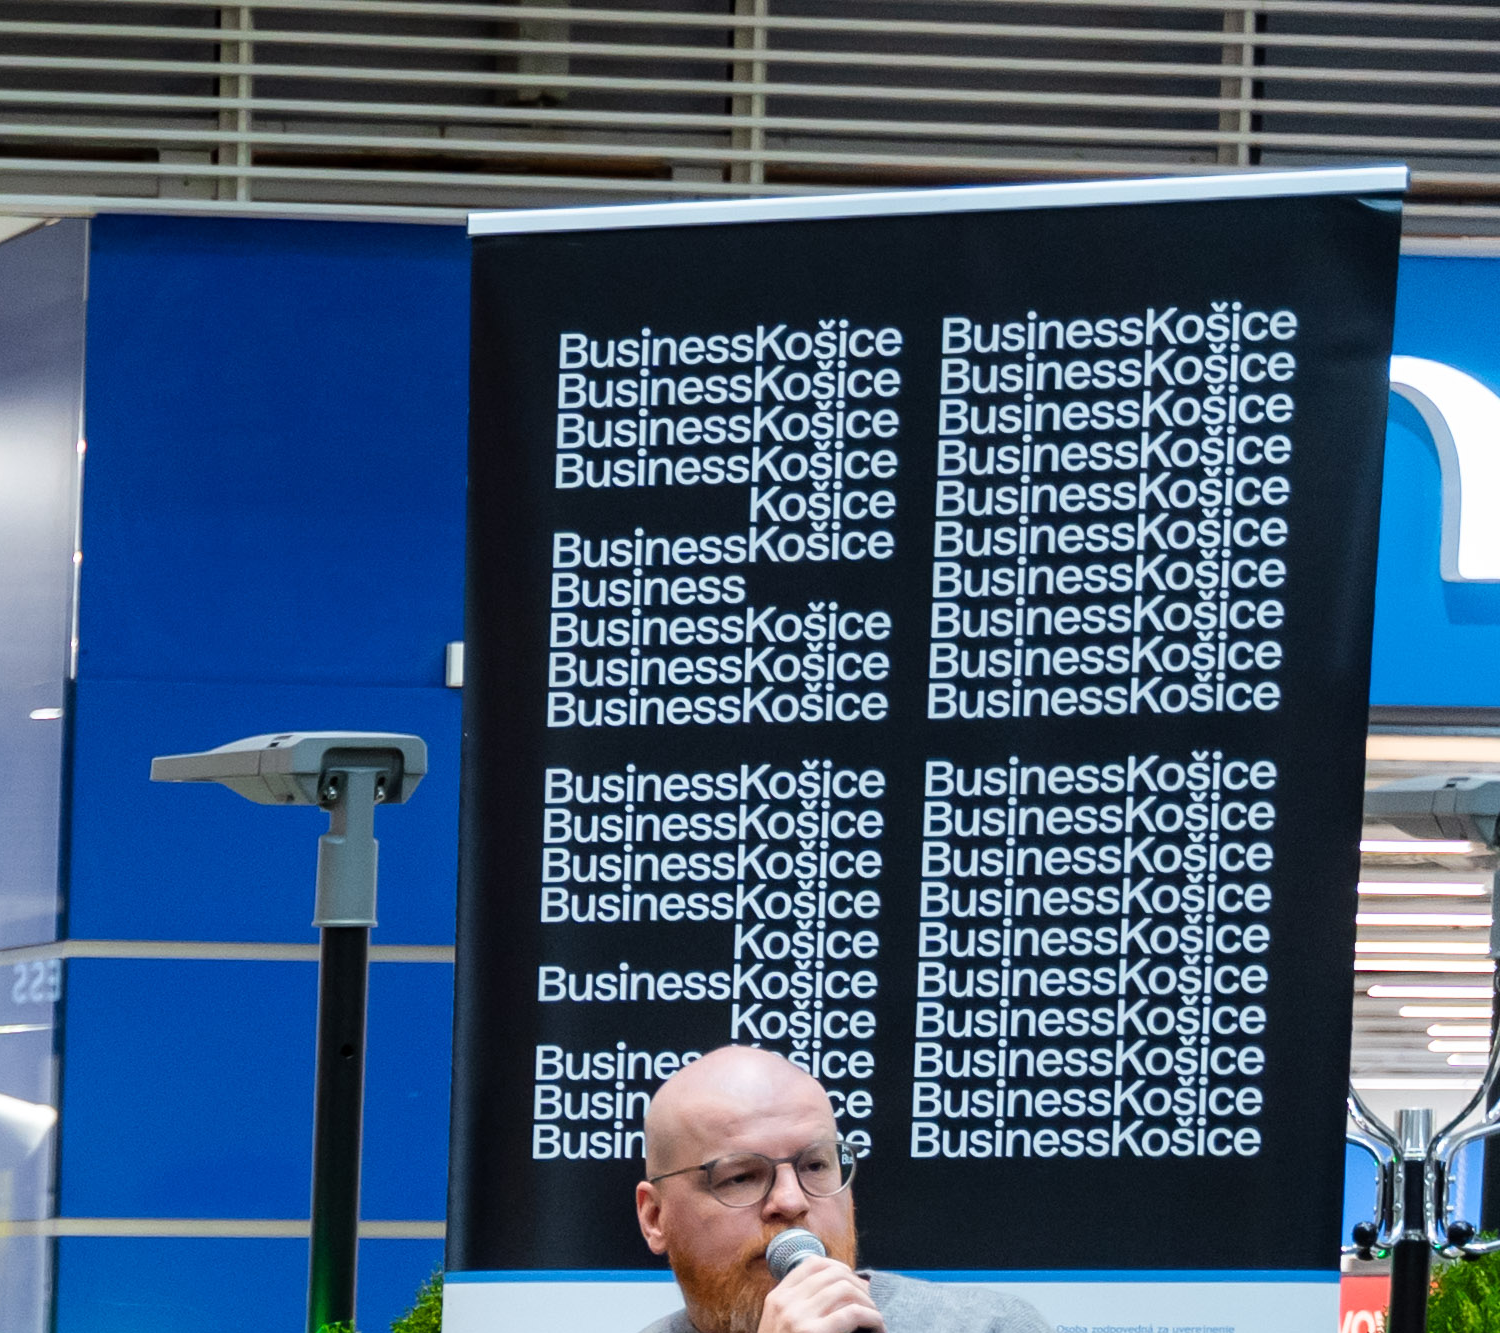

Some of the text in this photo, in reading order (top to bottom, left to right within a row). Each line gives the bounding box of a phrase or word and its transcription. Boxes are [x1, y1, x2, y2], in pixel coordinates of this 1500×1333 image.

[560, 317, 902, 370] BusinessKošice
[942, 300, 1297, 355] BusinessKošice
[558, 358, 900, 410] BusinessKošice
[941, 341, 1295, 395] BusinessKošice
[557, 398, 899, 450] BusinessKošice
[939, 382, 1294, 436] BusinessKošice
[556, 439, 897, 489] BusinessKošice
[938, 424, 1291, 477] BusinessKošice
[750, 479, 896, 523] Košice
[936, 465, 1290, 517] BusinessKošice
[553, 520, 894, 569] BusinessKošice
[934, 506, 1288, 558] BusinessKošice
[552, 569, 745, 609] Business
[933, 548, 1286, 599] BusinessKošice
[550, 601, 891, 648] BusinessKošice
[931, 589, 1284, 639] BusinessKošice
[549, 641, 889, 688] BusinessKošice
[929, 630, 1282, 679] BusinessKošice
[547, 682, 888, 728] BusinessKošice
[928, 671, 1280, 720] BusinessKošice
[545, 759, 885, 804] BusinessKošice
[925, 750, 1277, 797] BusinessKošice
[544, 799, 883, 844] BusinessKošice
[923, 791, 1275, 838] BusinessKošice
[542, 839, 882, 883] BusinessKošice
[922, 832, 1273, 878] BusinessKošice
[541, 879, 880, 923] BusinessKošice
[920, 873, 1271, 918] BusinessKošice
[734, 920, 879, 960] Košice
[919, 913, 1270, 958] BusinessKošice
[538, 960, 878, 1002] BusinessKošice
[917, 954, 1268, 998] BusinessKošice
[731, 999, 876, 1040] Košice
[916, 995, 1266, 1038] BusinessKošice
[914, 1035, 1265, 1078] BusinessKošice
[913, 1076, 1263, 1118] BusinessKošice
[911, 1117, 1261, 1158] BusinessKošice
